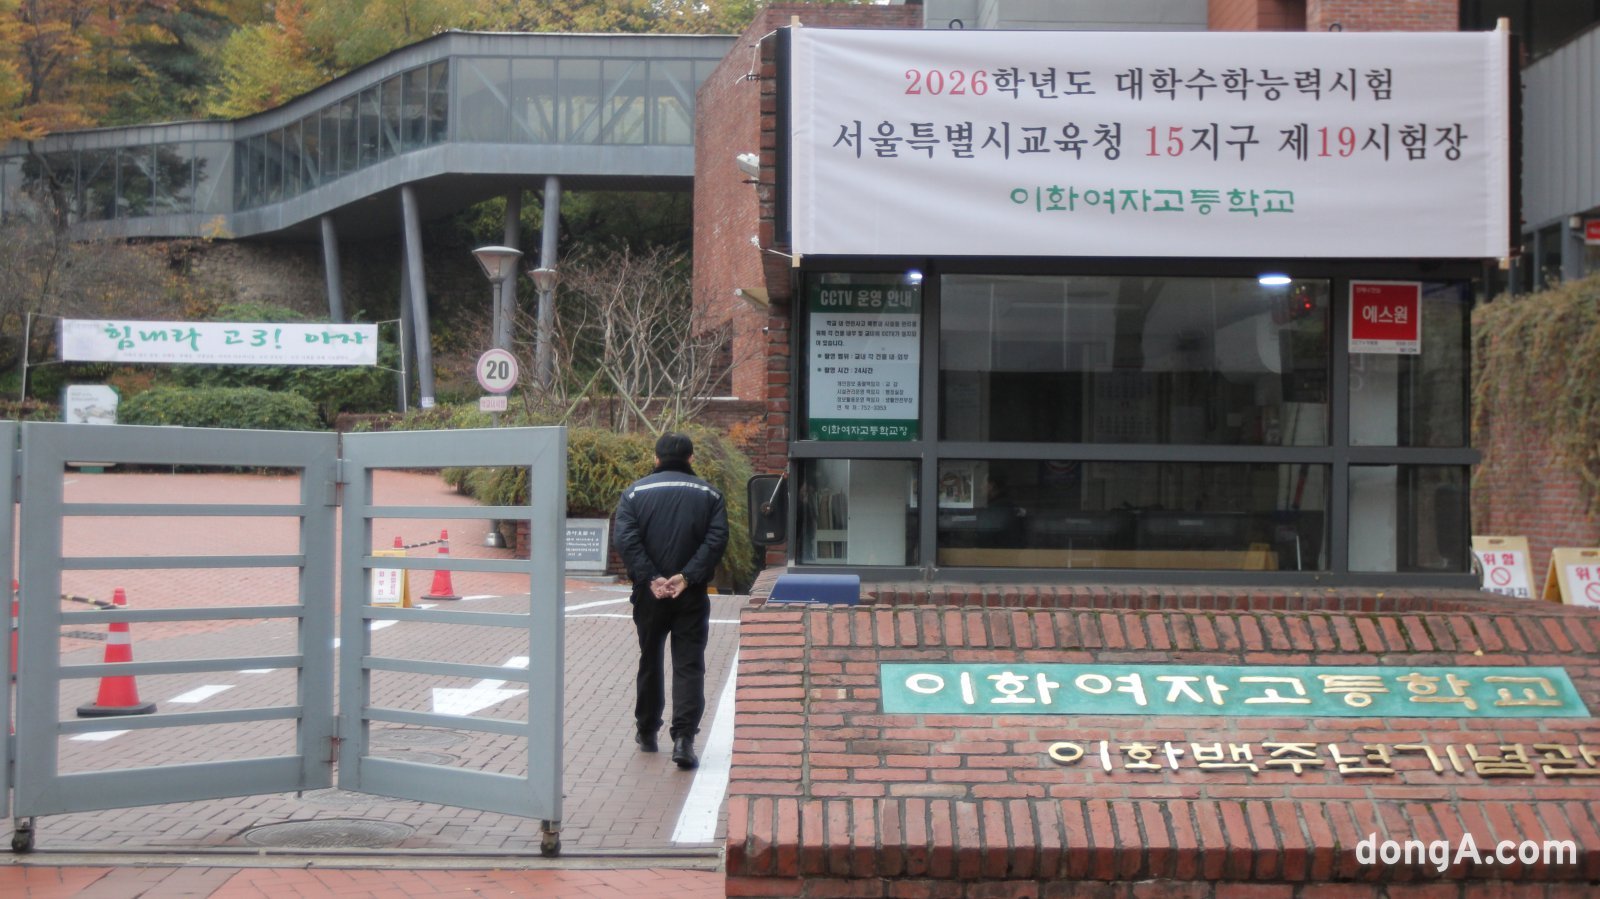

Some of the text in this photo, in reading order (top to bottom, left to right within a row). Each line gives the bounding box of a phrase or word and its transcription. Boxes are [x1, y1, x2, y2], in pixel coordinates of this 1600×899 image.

[904, 67, 1393, 101] 2026학년도 대학수학능력시험
[832, 120, 1468, 162] 서울특별시교육청 15지구 제19시험장
[1010, 184, 1295, 217] 이화여자고등학교
[820, 290, 912, 308] CCTV 운영 안내
[1362, 305, 1408, 324] 에스원
[104, 322, 369, 351] 힘내라 고3! 아자
[486, 360, 510, 380] 20
[821, 425, 908, 436] 이화여자고등학교장
[904, 671, 1565, 711] 이화여자고등학교
[1048, 740, 1600, 778] 이화백주년기념관
